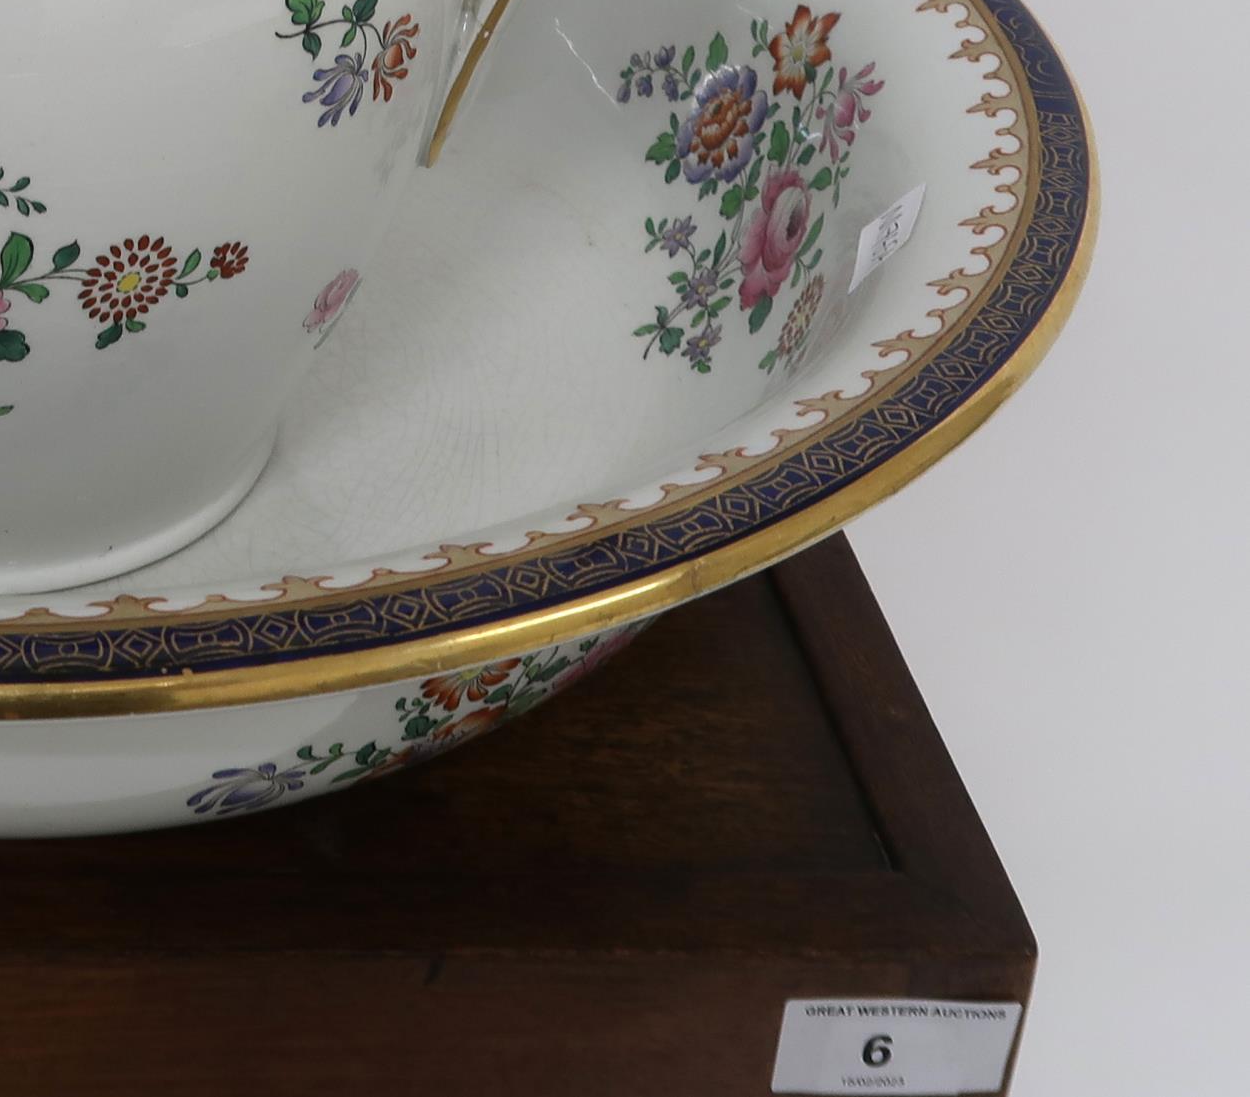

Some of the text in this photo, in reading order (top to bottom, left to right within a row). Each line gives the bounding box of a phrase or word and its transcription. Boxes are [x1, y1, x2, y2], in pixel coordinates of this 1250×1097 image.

[805, 1006, 1007, 1021] GREAT WESTERN AUCTIONS
[862, 1034, 893, 1068] 6
